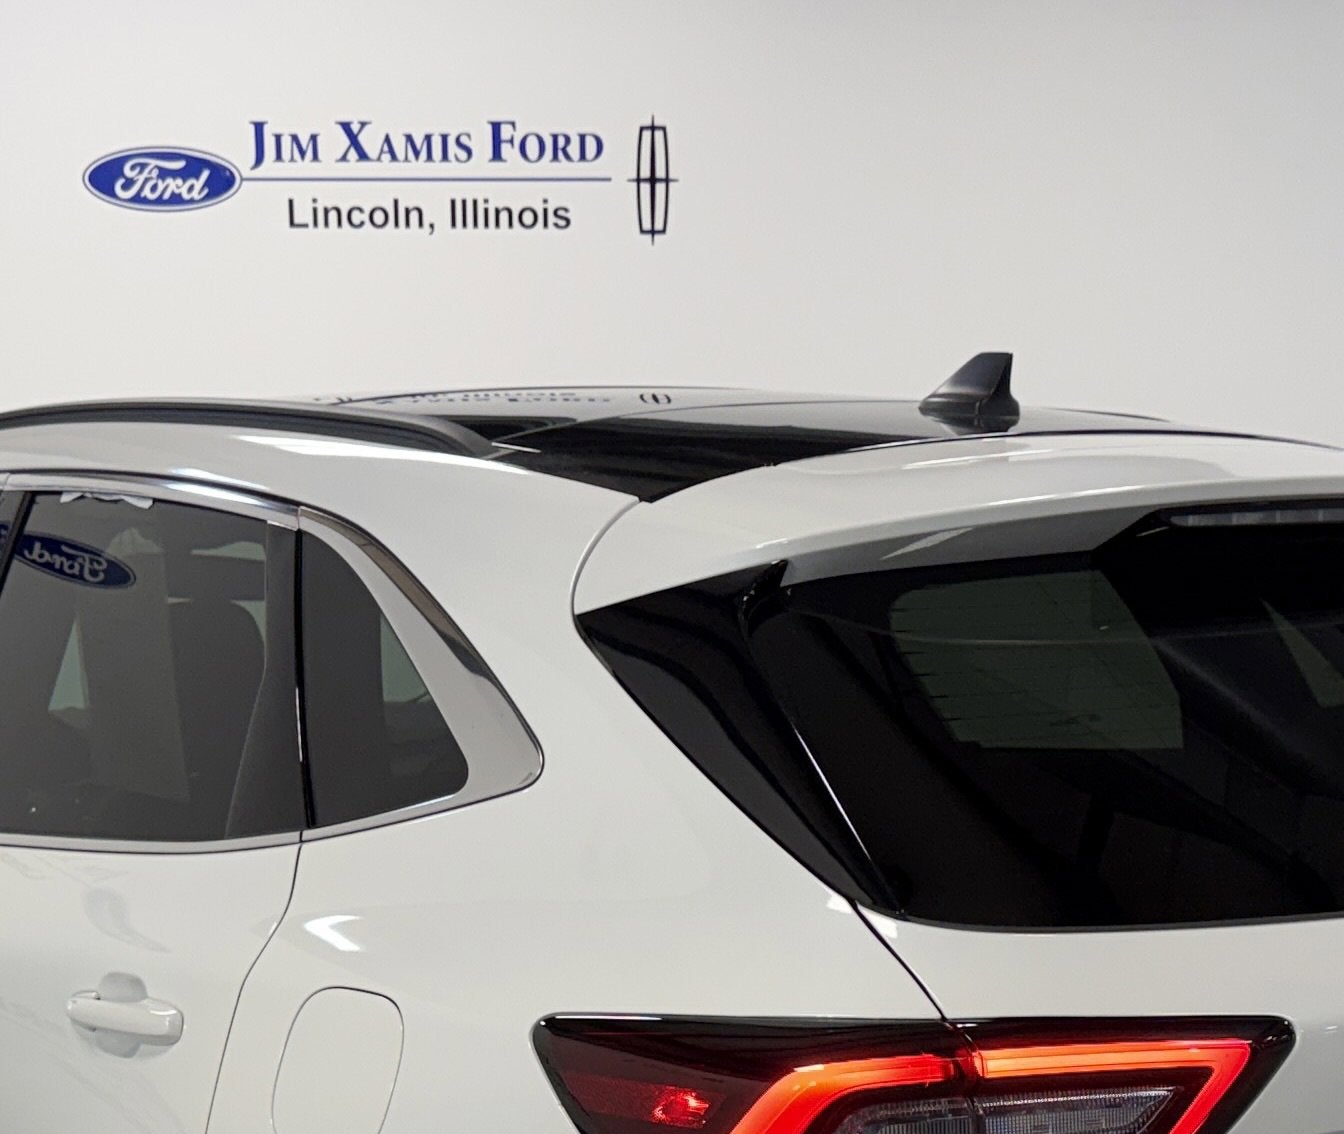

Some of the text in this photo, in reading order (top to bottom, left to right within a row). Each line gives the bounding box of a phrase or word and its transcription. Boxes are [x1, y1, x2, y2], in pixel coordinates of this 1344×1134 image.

[249, 121, 604, 170] JIM XAMIS FORD
[114, 157, 210, 201] Ford
[287, 197, 571, 236] Lincoln, Illinois
